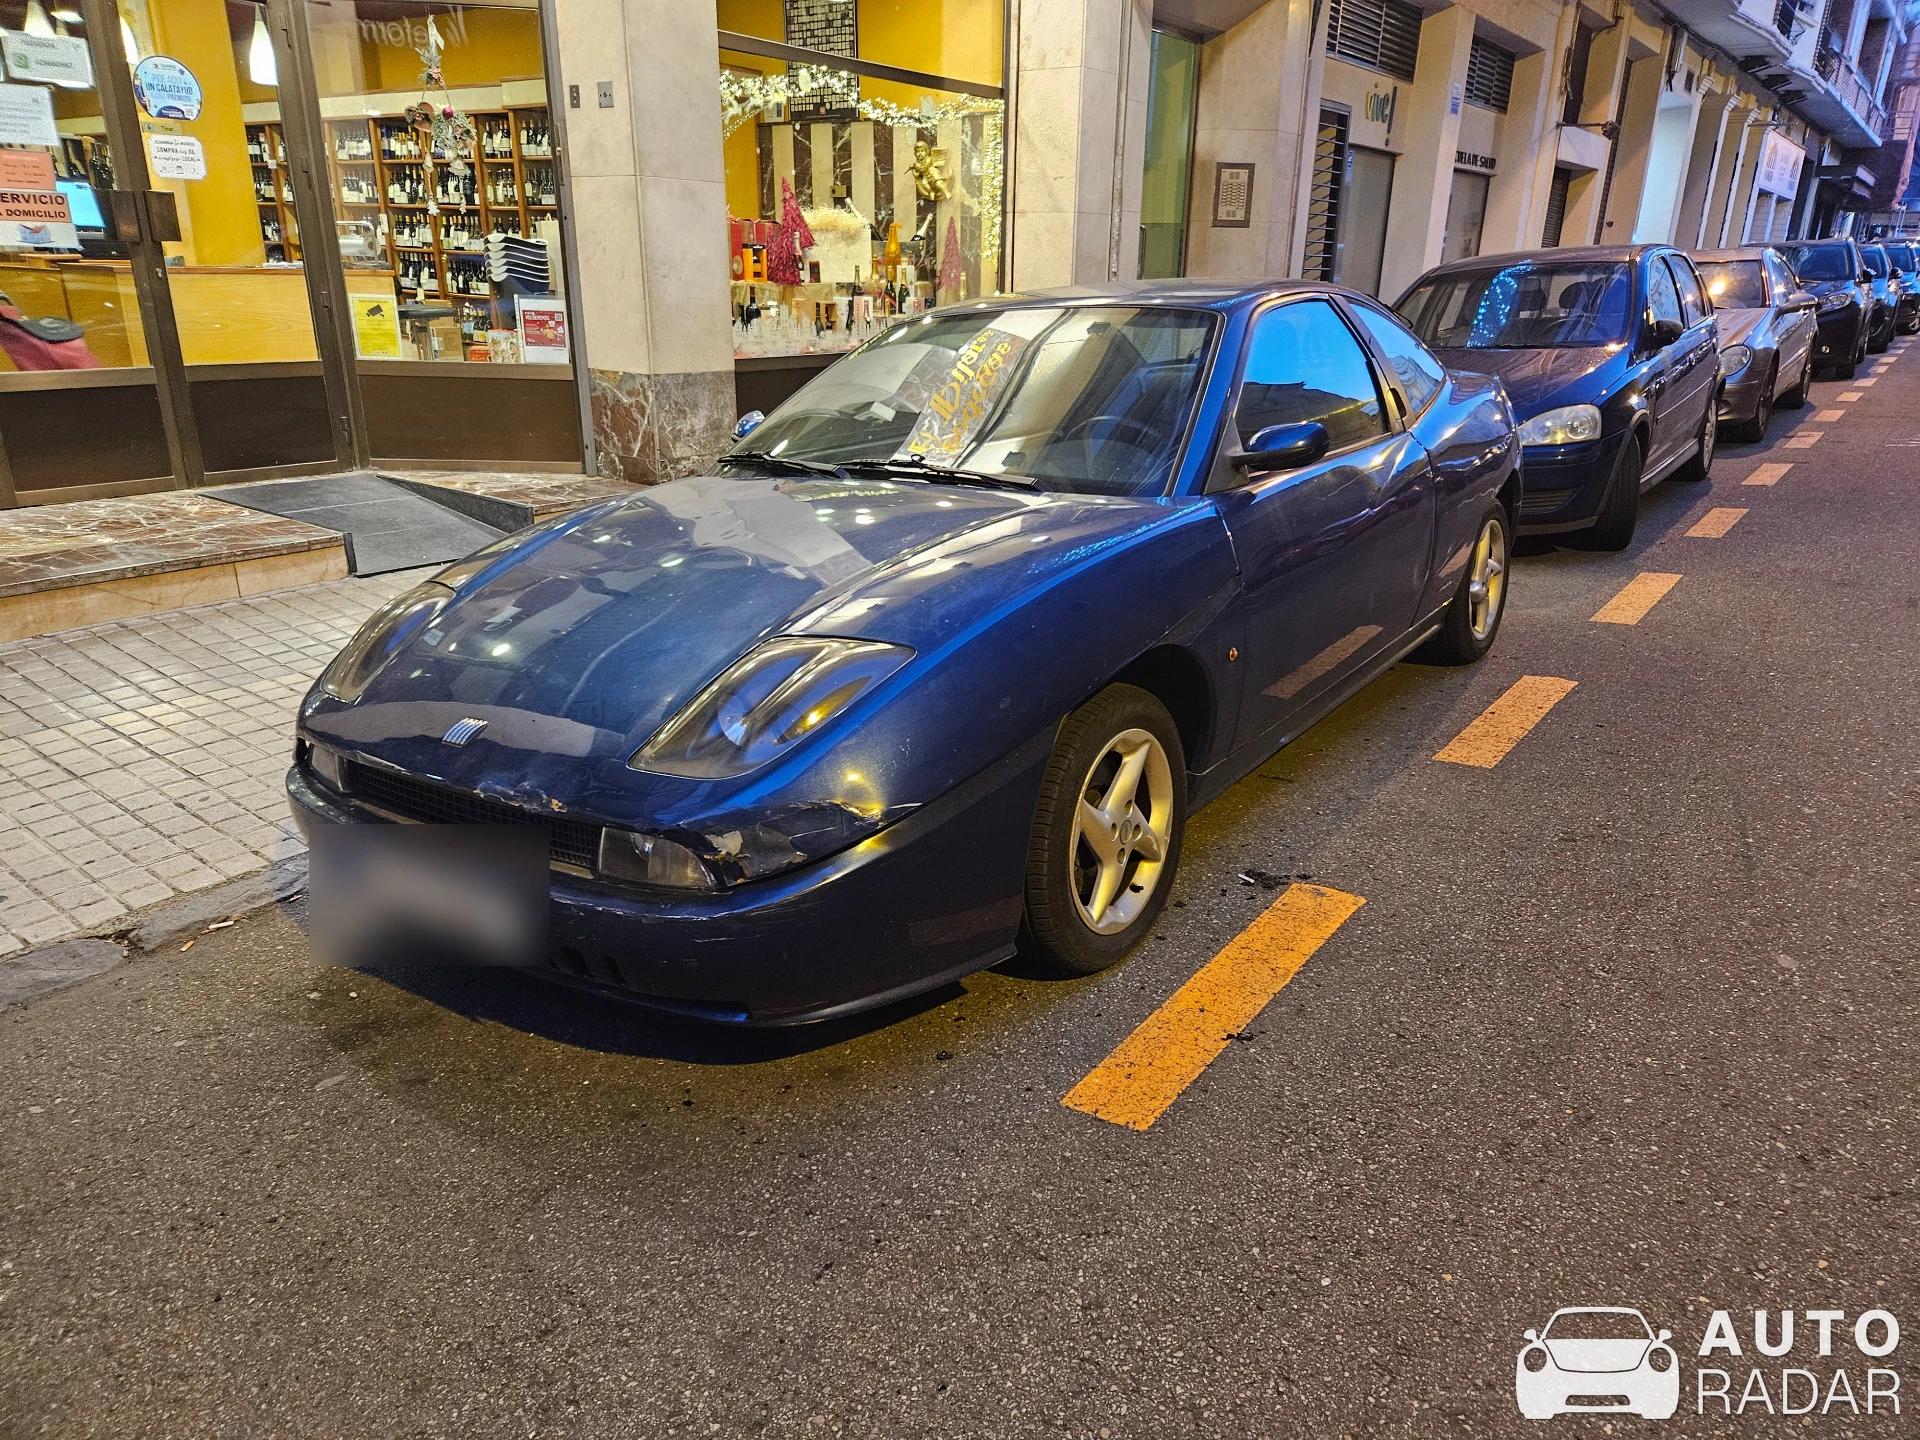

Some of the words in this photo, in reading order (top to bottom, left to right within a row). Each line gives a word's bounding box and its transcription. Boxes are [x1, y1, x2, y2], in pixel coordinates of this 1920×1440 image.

[146, 82, 155, 91] UN
[156, 84, 193, 95] CALATAYUD
[1455, 150, 1471, 165] CUELA
[0, 193, 66, 206] ERVICIO
[5, 209, 66, 219] DOMICILIO
